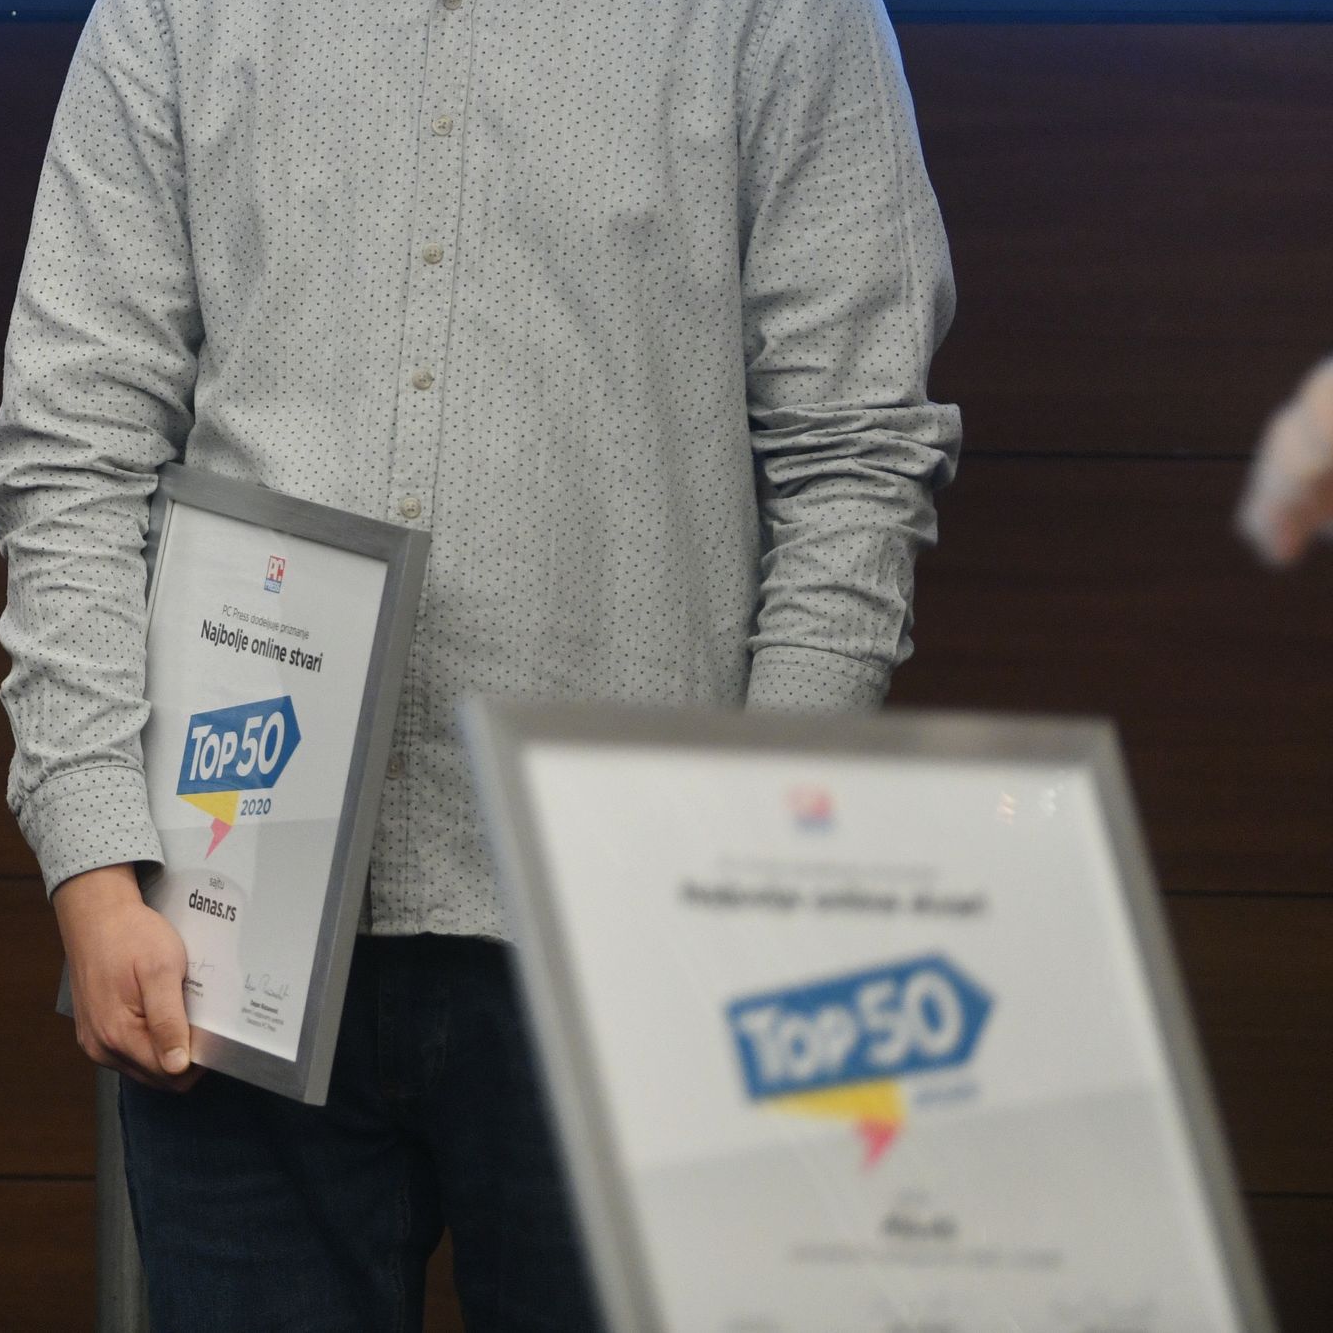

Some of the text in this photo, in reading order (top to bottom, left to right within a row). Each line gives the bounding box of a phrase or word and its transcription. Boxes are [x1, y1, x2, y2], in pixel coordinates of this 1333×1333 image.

[222, 604, 232, 617] PC
[233, 607, 249, 622] Press
[201, 619, 323, 673] Najbolje online stvari
[189, 711, 285, 781] TOP 50
[240, 798, 271, 816] 2020
[189, 889, 237, 923] danas.rs
[856, 969, 964, 1066] 50
